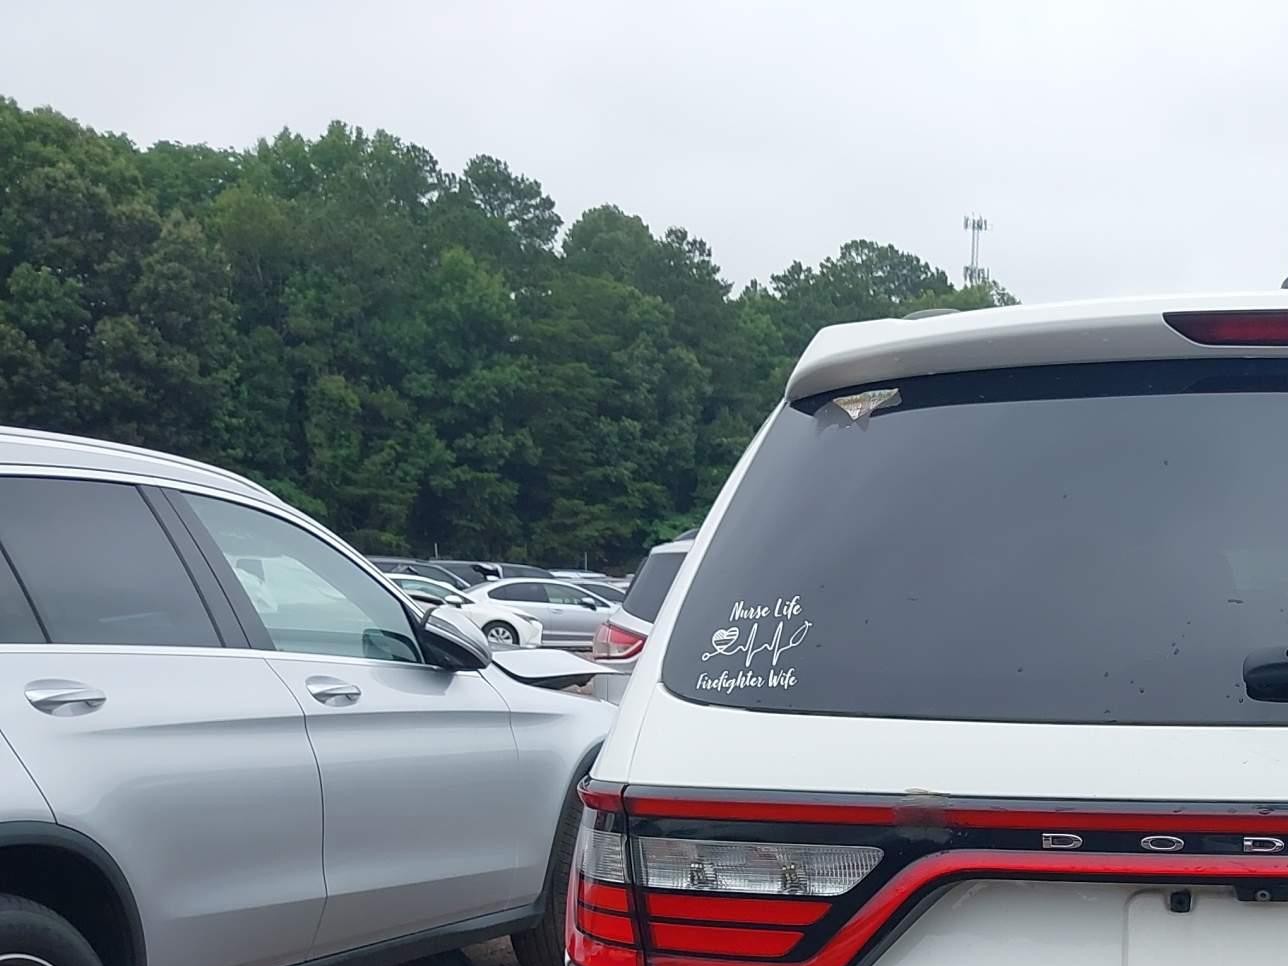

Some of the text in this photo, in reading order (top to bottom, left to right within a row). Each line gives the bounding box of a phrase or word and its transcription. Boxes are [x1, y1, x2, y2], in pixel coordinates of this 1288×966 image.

[729, 595, 802, 621] Nurse Life
[696, 668, 798, 694] Firefighter Wife
